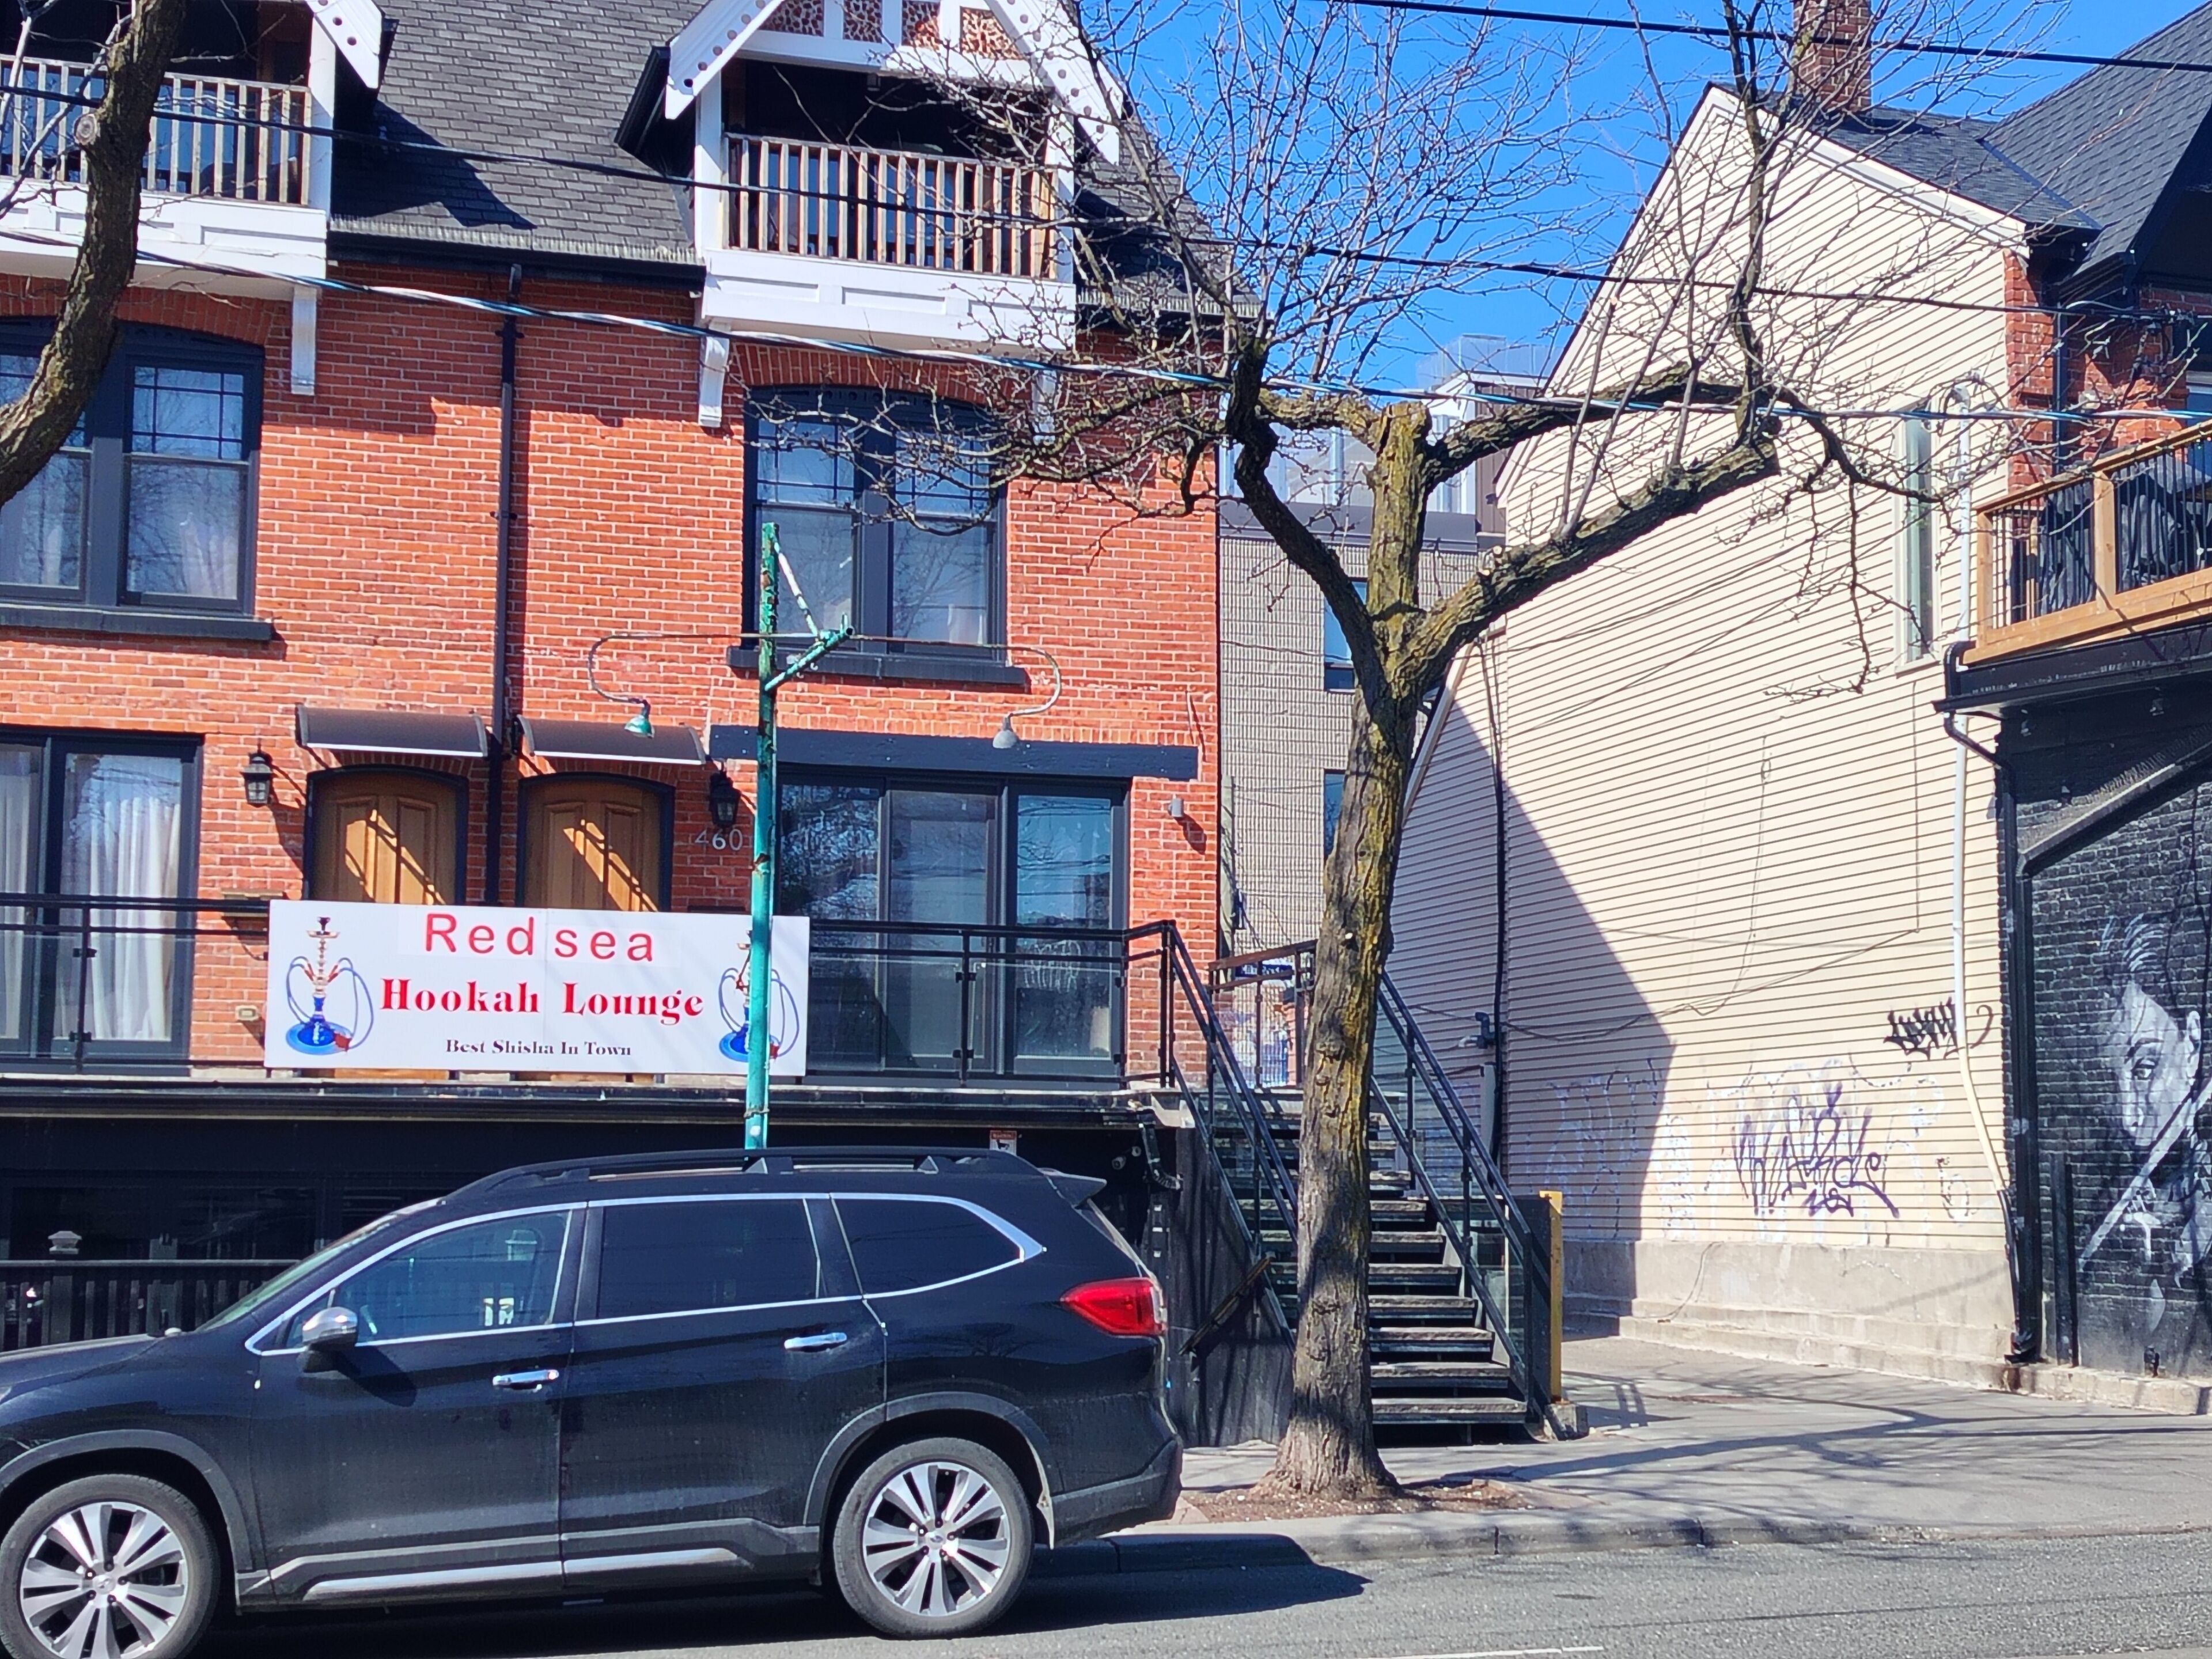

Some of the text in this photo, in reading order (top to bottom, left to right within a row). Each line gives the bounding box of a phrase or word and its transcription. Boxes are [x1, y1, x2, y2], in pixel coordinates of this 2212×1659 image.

[694, 828, 743, 851] 460
[381, 978, 704, 1025] Hookah Lounge
[446, 1039, 631, 1056] Best Shisha In Town
